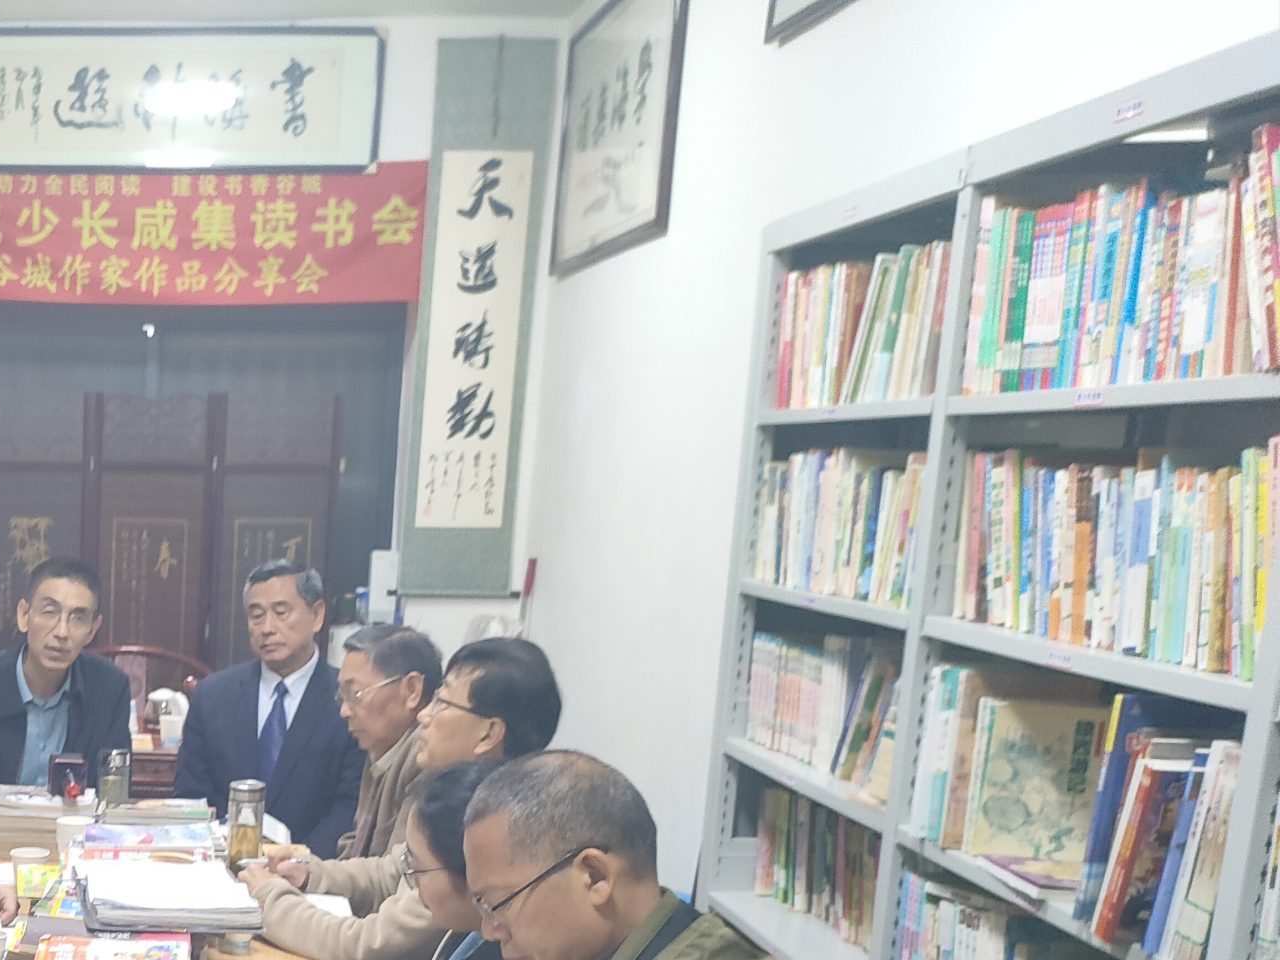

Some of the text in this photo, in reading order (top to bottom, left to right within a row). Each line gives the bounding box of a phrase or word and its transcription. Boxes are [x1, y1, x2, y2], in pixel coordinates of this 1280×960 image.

[171, 173, 323, 197] 建设书香谷城
